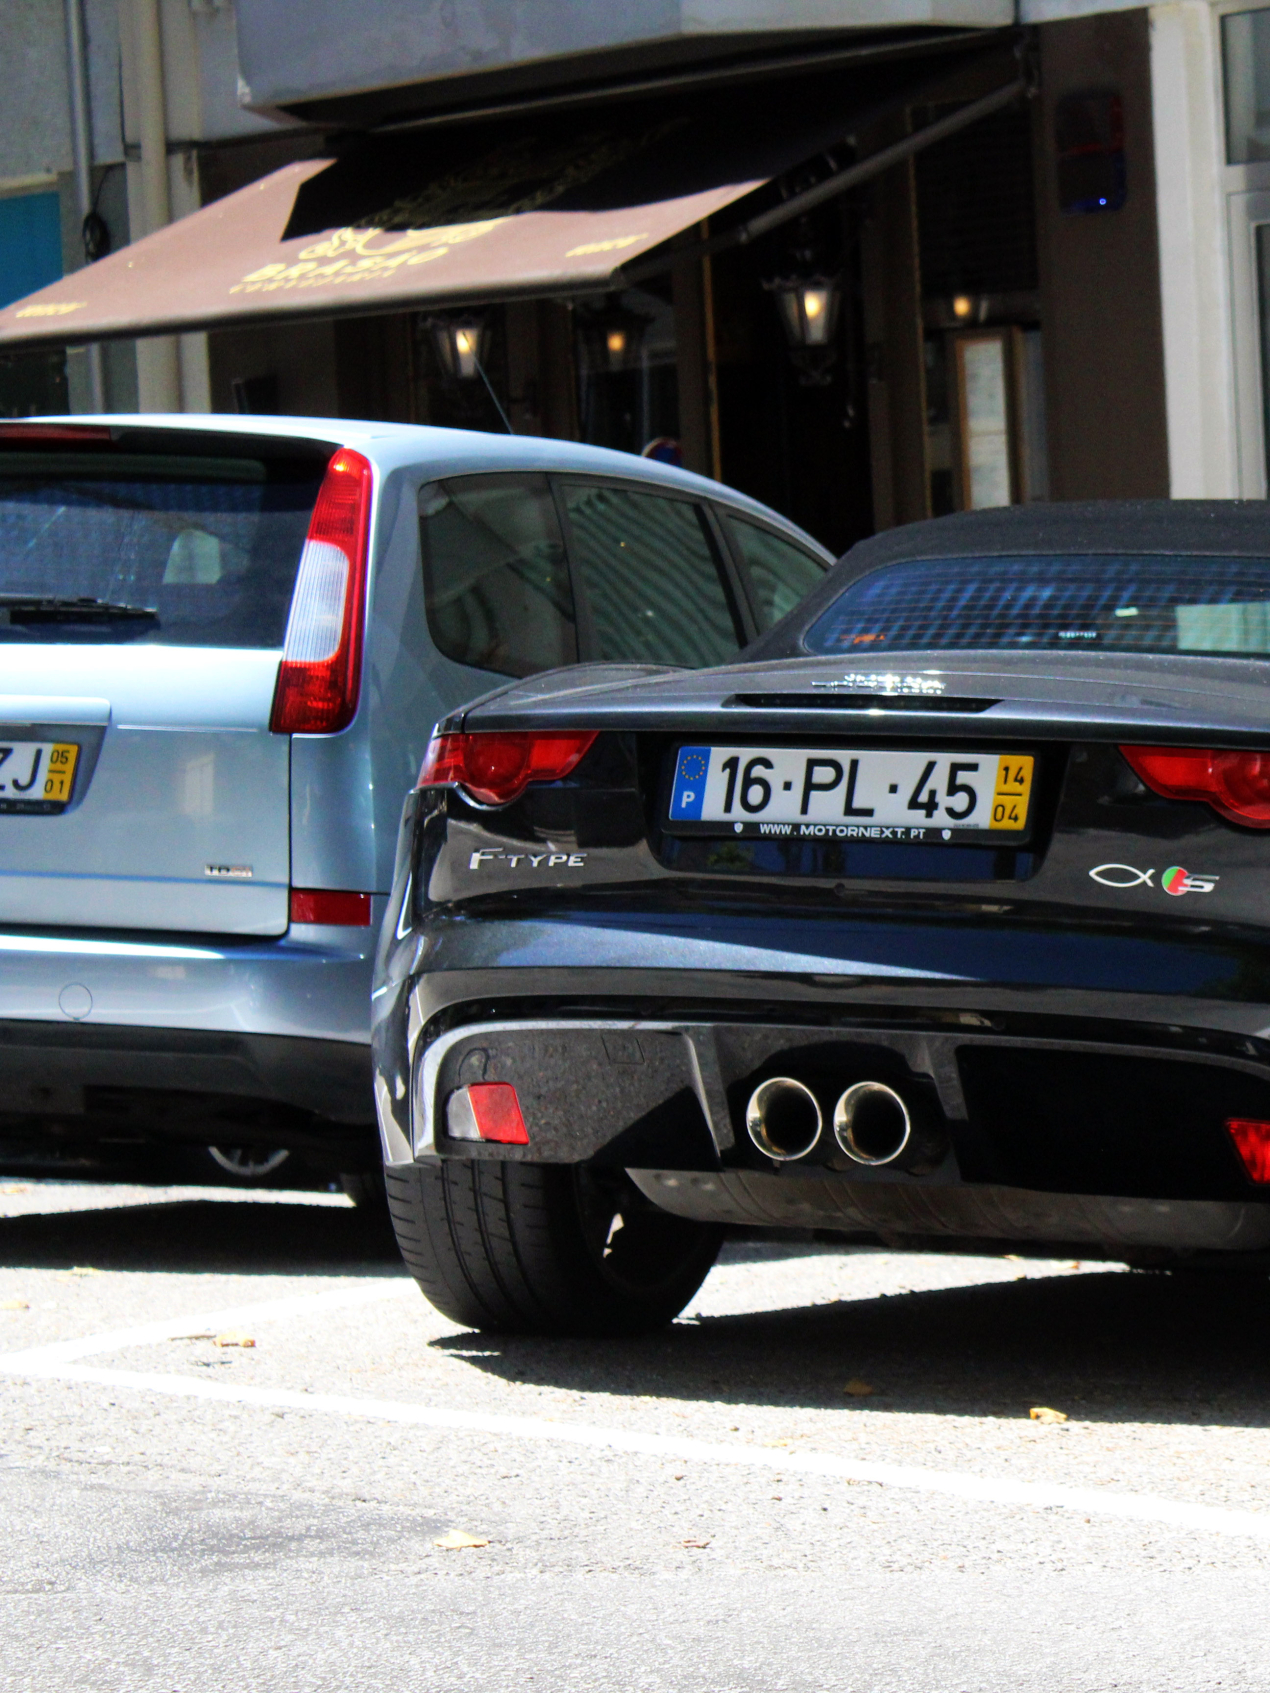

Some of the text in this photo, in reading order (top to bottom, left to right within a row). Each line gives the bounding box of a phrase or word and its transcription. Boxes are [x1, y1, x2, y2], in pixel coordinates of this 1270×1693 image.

[50, 750, 70, 765] 05
[1003, 766, 1025, 786] 14
[44, 779, 65, 794] 01
[681, 790, 696, 808] P
[993, 804, 1019, 823] 04
[469, 847, 588, 870] F-TYPE
